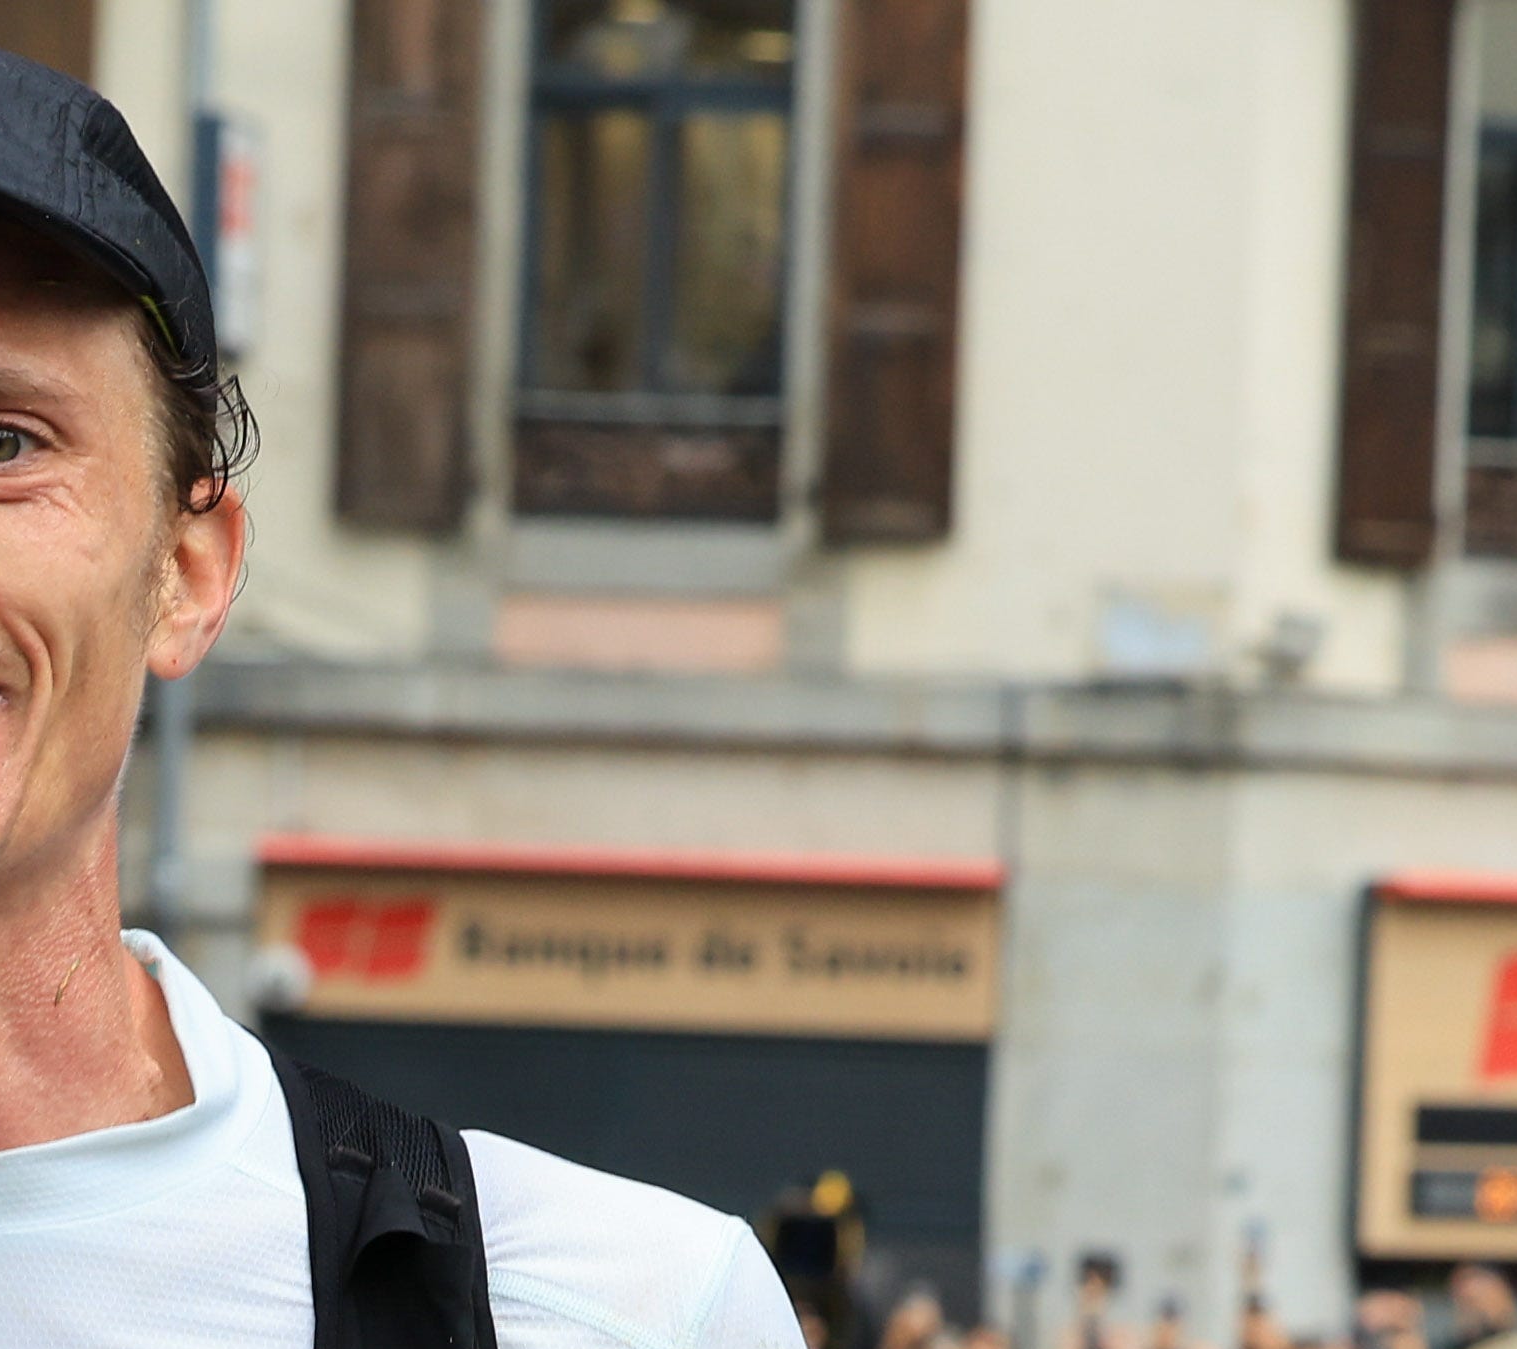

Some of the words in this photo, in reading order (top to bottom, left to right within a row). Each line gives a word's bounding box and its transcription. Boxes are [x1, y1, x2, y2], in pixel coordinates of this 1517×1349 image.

[456, 918, 669, 982] Banque
[694, 925, 758, 970] de
[782, 926, 971, 975] Savoie
